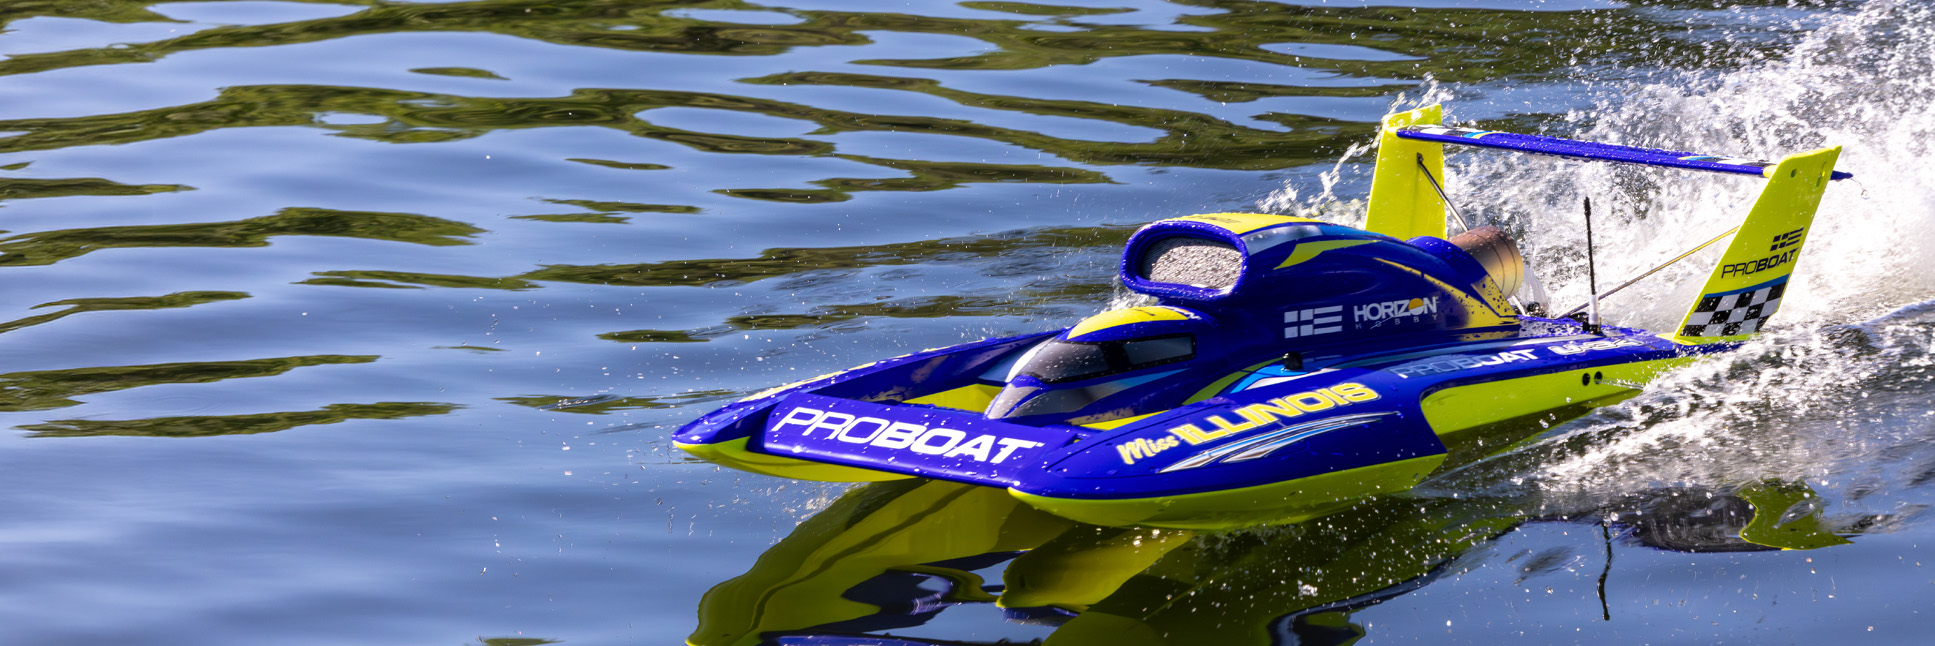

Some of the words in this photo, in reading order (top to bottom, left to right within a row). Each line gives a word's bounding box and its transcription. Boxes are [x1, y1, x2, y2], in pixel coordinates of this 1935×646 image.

[1721, 247, 1799, 279] PROBOAT
[1353, 296, 1438, 323] HORIZON
[771, 406, 1036, 464] PROBOAT
[1116, 437, 1179, 465] Miss
[1167, 382, 1381, 446] ILLINOIS
